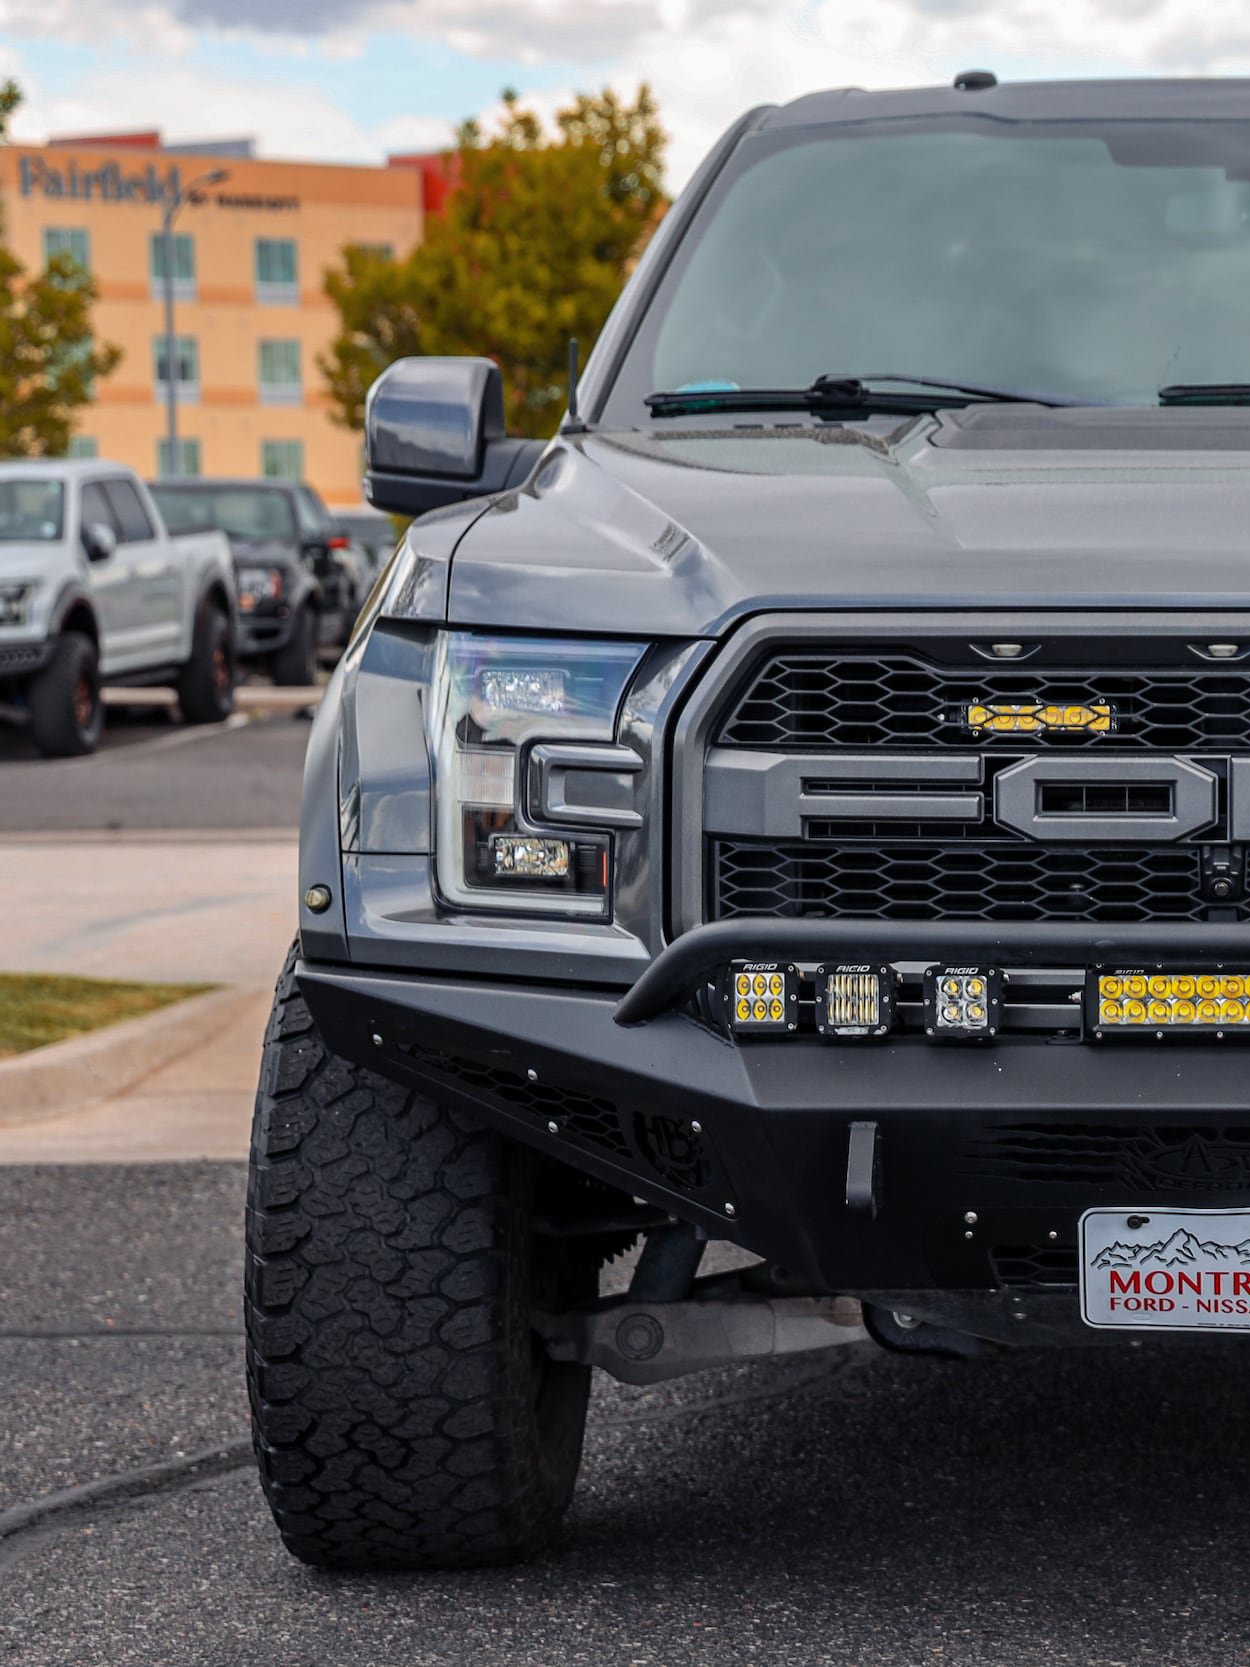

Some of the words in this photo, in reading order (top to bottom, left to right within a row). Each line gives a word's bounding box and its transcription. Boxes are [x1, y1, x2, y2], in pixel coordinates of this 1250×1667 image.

[19, 155, 181, 208] Fairfield
[743, 962, 778, 971] RIGID
[836, 965, 871, 973] RIGID
[944, 966, 979, 975] RIGID
[1110, 1297, 1176, 1312] FORD
